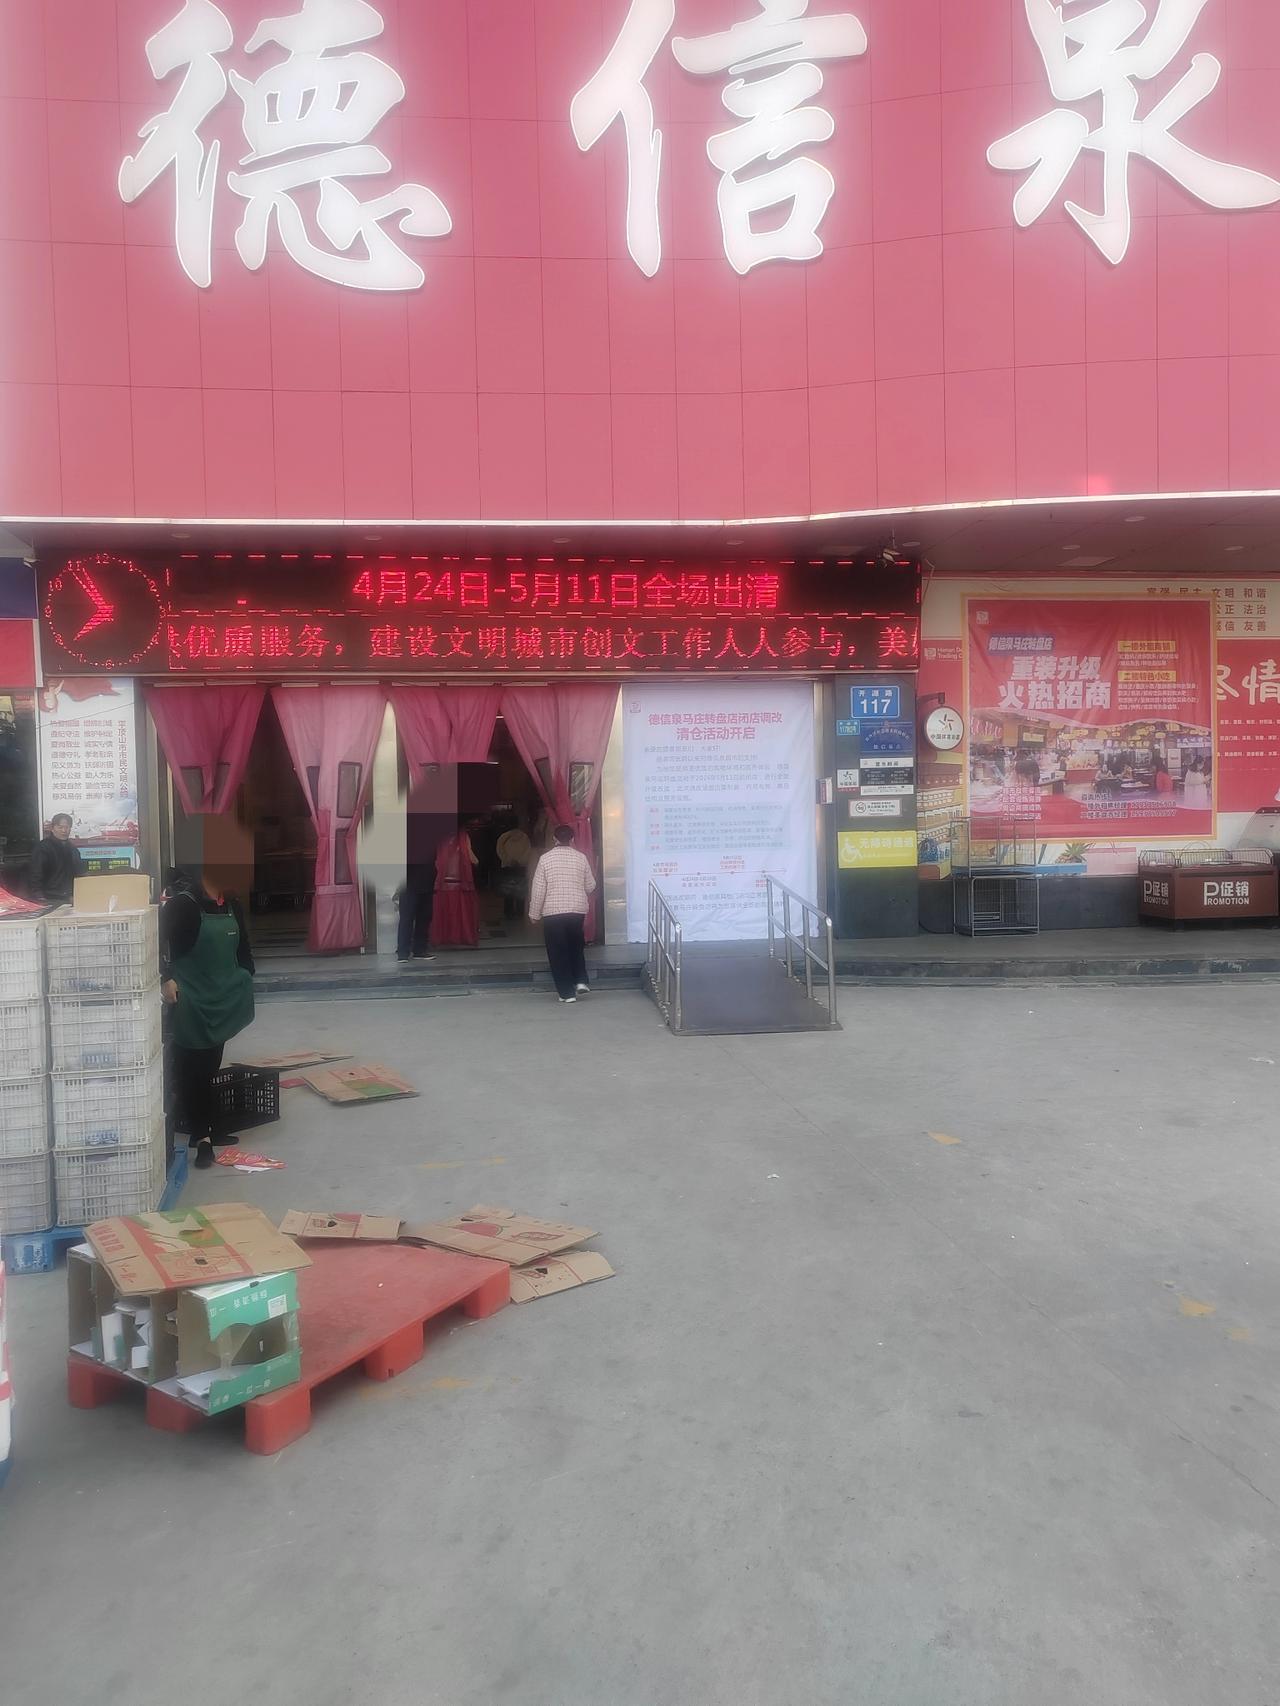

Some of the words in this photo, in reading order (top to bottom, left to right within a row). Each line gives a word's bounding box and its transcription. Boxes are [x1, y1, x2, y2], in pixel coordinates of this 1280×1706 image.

[118, 0, 1280, 291] 德信泉
[352, 571, 781, 609] 4月24日-5月11日全场出清
[1244, 588, 1266, 598] 和谐
[1244, 604, 1266, 614] 法治
[1244, 621, 1266, 631] 友善
[988, 637, 1054, 650] 德信泉马庄转盘店
[1011, 656, 1102, 680] 重装升级
[857, 689, 894, 697] 开源路
[997, 682, 1112, 710] 火热招商
[860, 698, 892, 714] 117
[648, 712, 783, 726] 德信泉马庄转盘店闭店调改
[676, 727, 756, 741] 清仓活动开启
[860, 837, 914, 848] 无障碍通道
[1220, 881, 1250, 897] 促销
